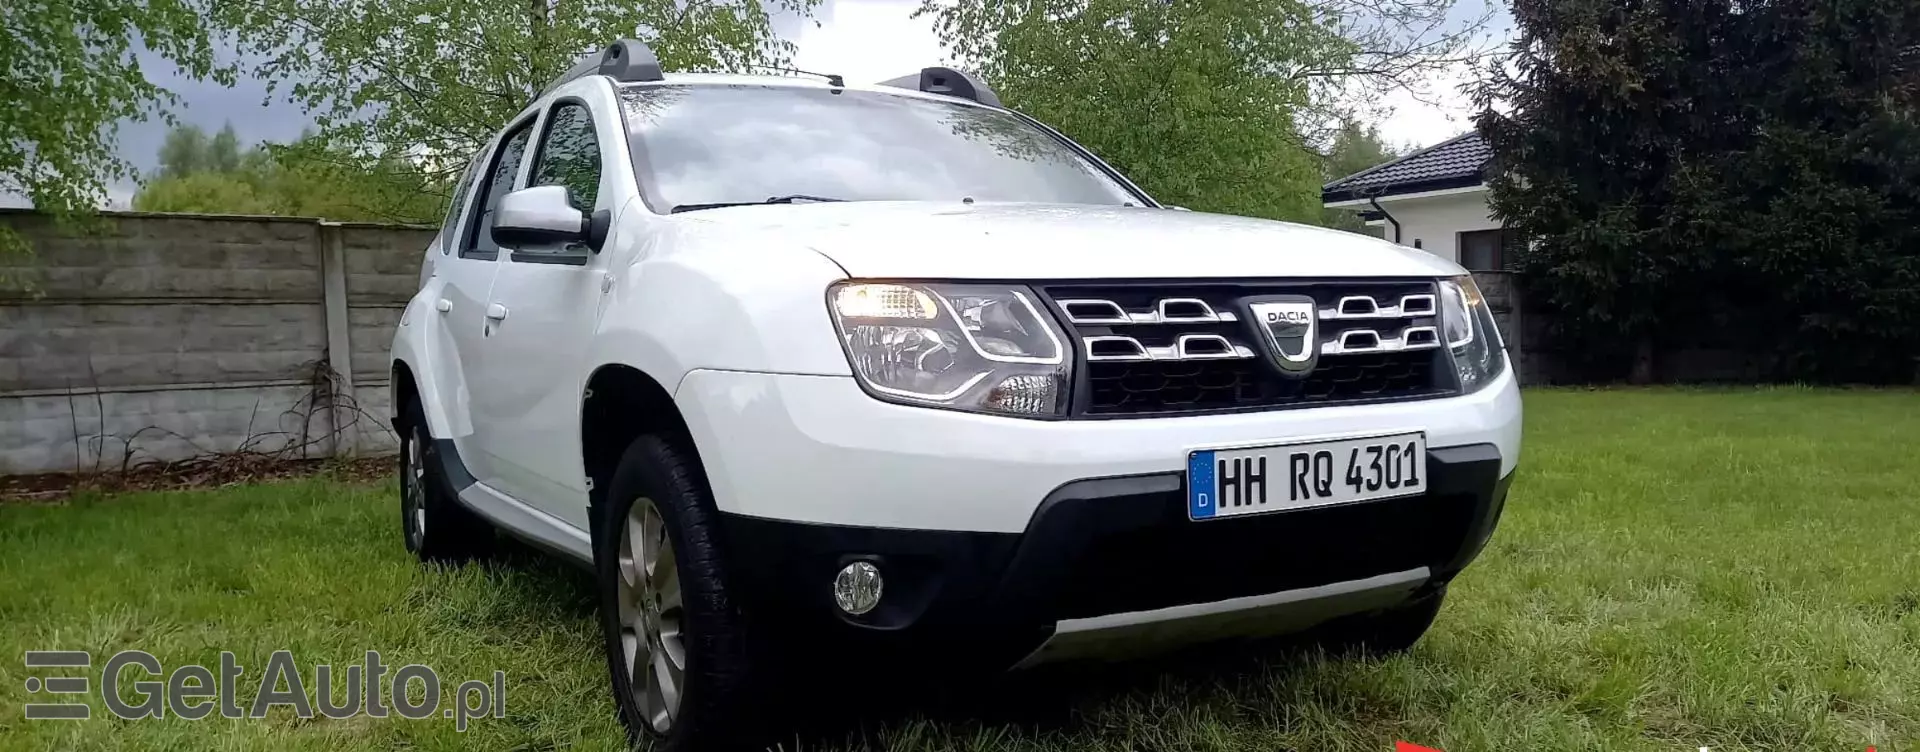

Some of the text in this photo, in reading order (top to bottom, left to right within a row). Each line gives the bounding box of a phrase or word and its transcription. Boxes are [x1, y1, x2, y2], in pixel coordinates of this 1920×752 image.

[1267, 311, 1309, 321] DACIA
[1218, 441, 1419, 508] HH RQ 4301
[1198, 493, 1208, 508] D
